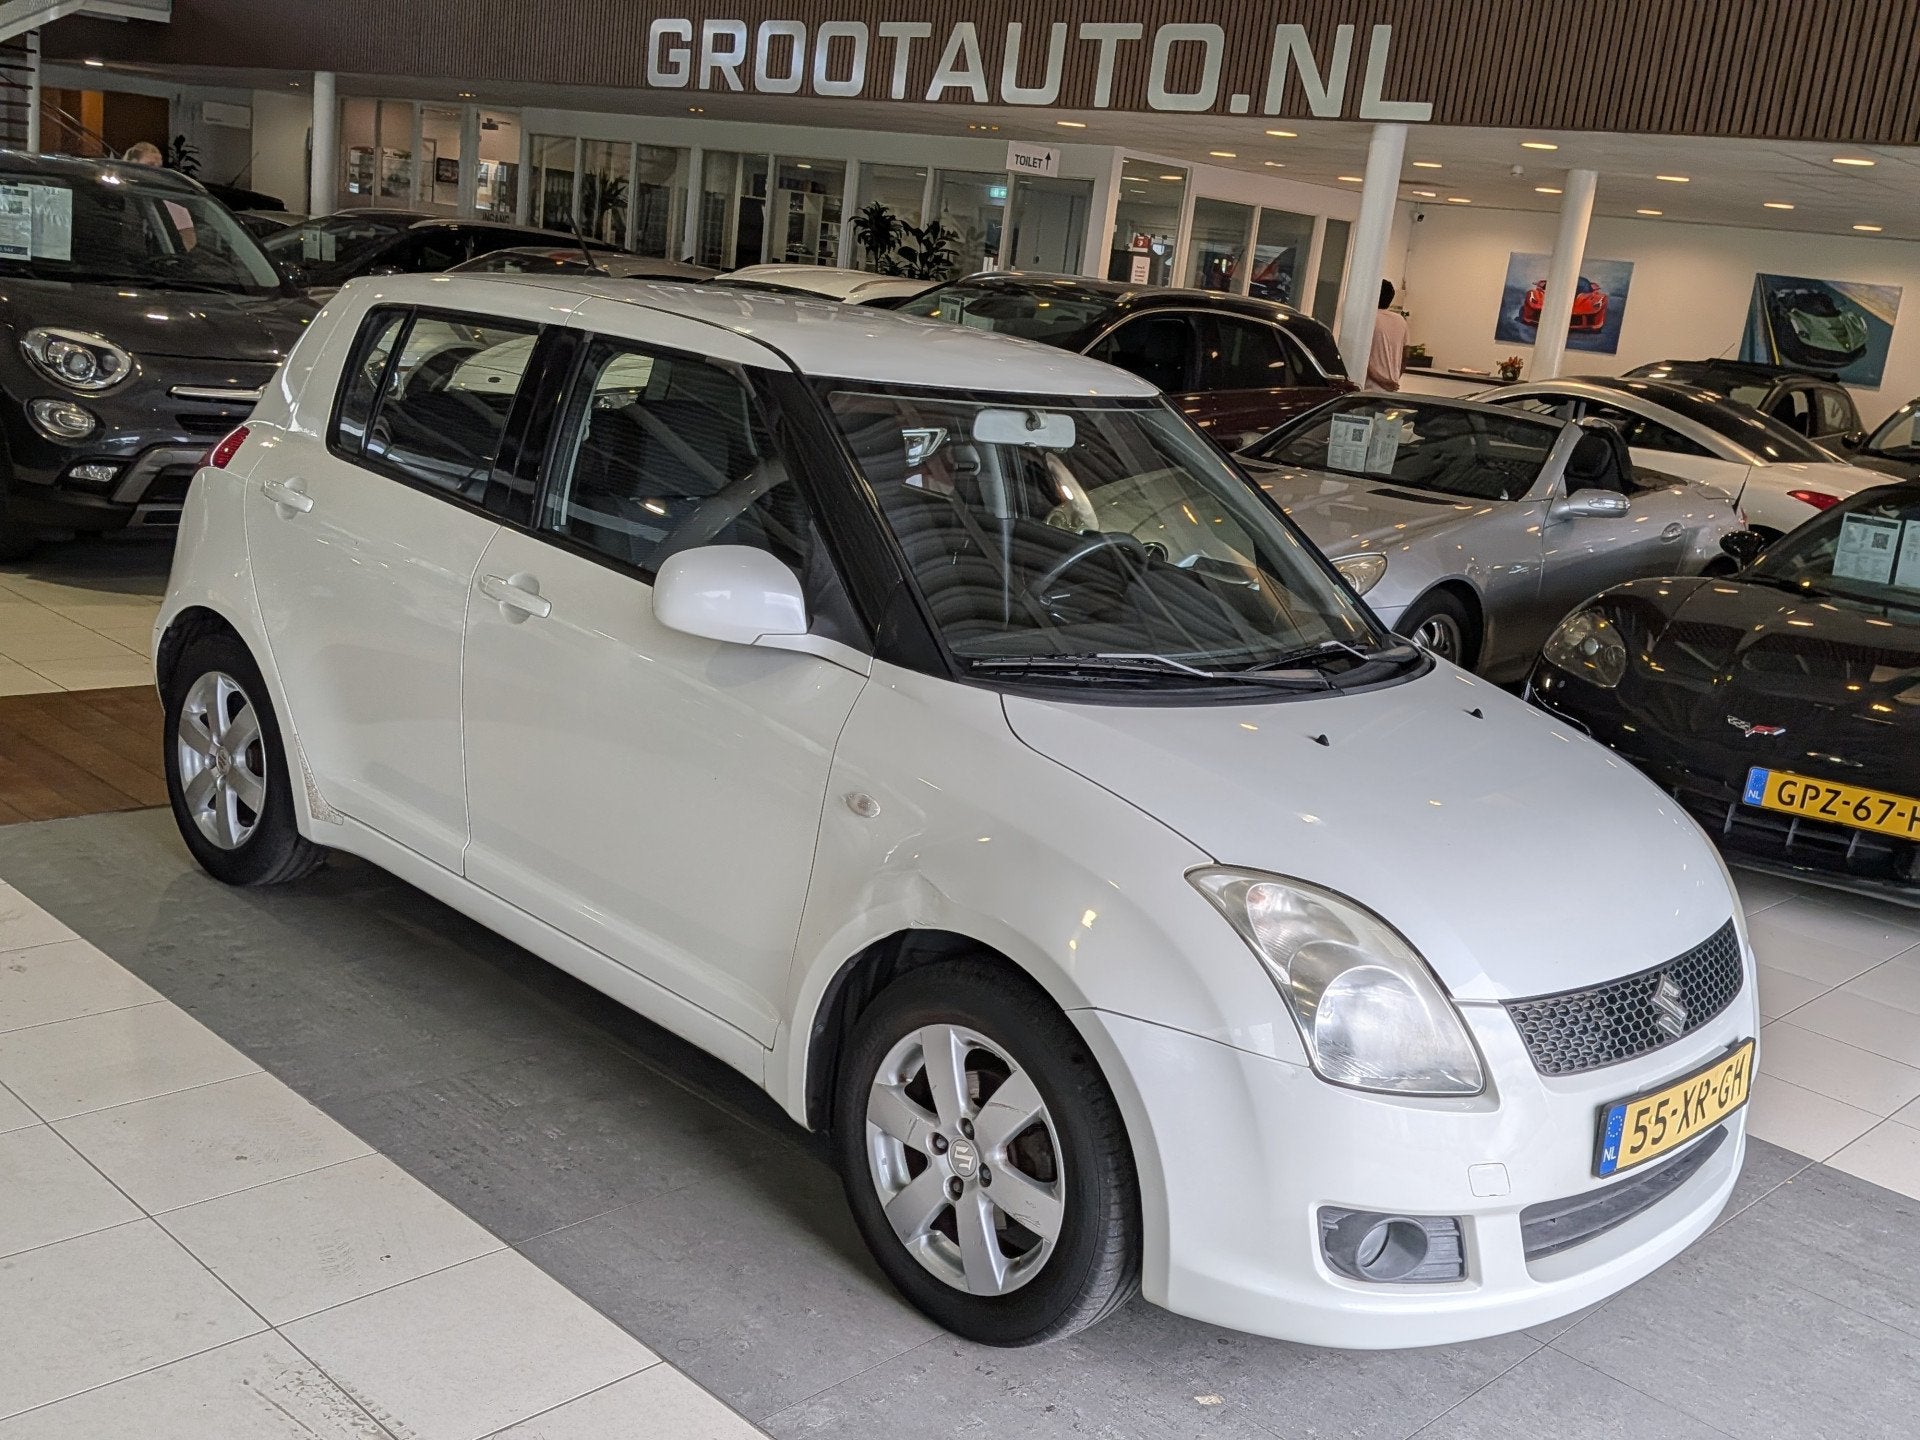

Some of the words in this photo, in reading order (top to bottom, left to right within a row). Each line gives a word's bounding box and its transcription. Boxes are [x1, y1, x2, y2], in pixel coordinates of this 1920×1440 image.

[647, 18, 1433, 122] GROOTAUTO.NL
[1015, 153, 1043, 168] TOILET
[1748, 789, 1761, 800] NL
[1629, 1053, 1746, 1154] 55-XR-GH
[1603, 1146, 1616, 1163] NL
